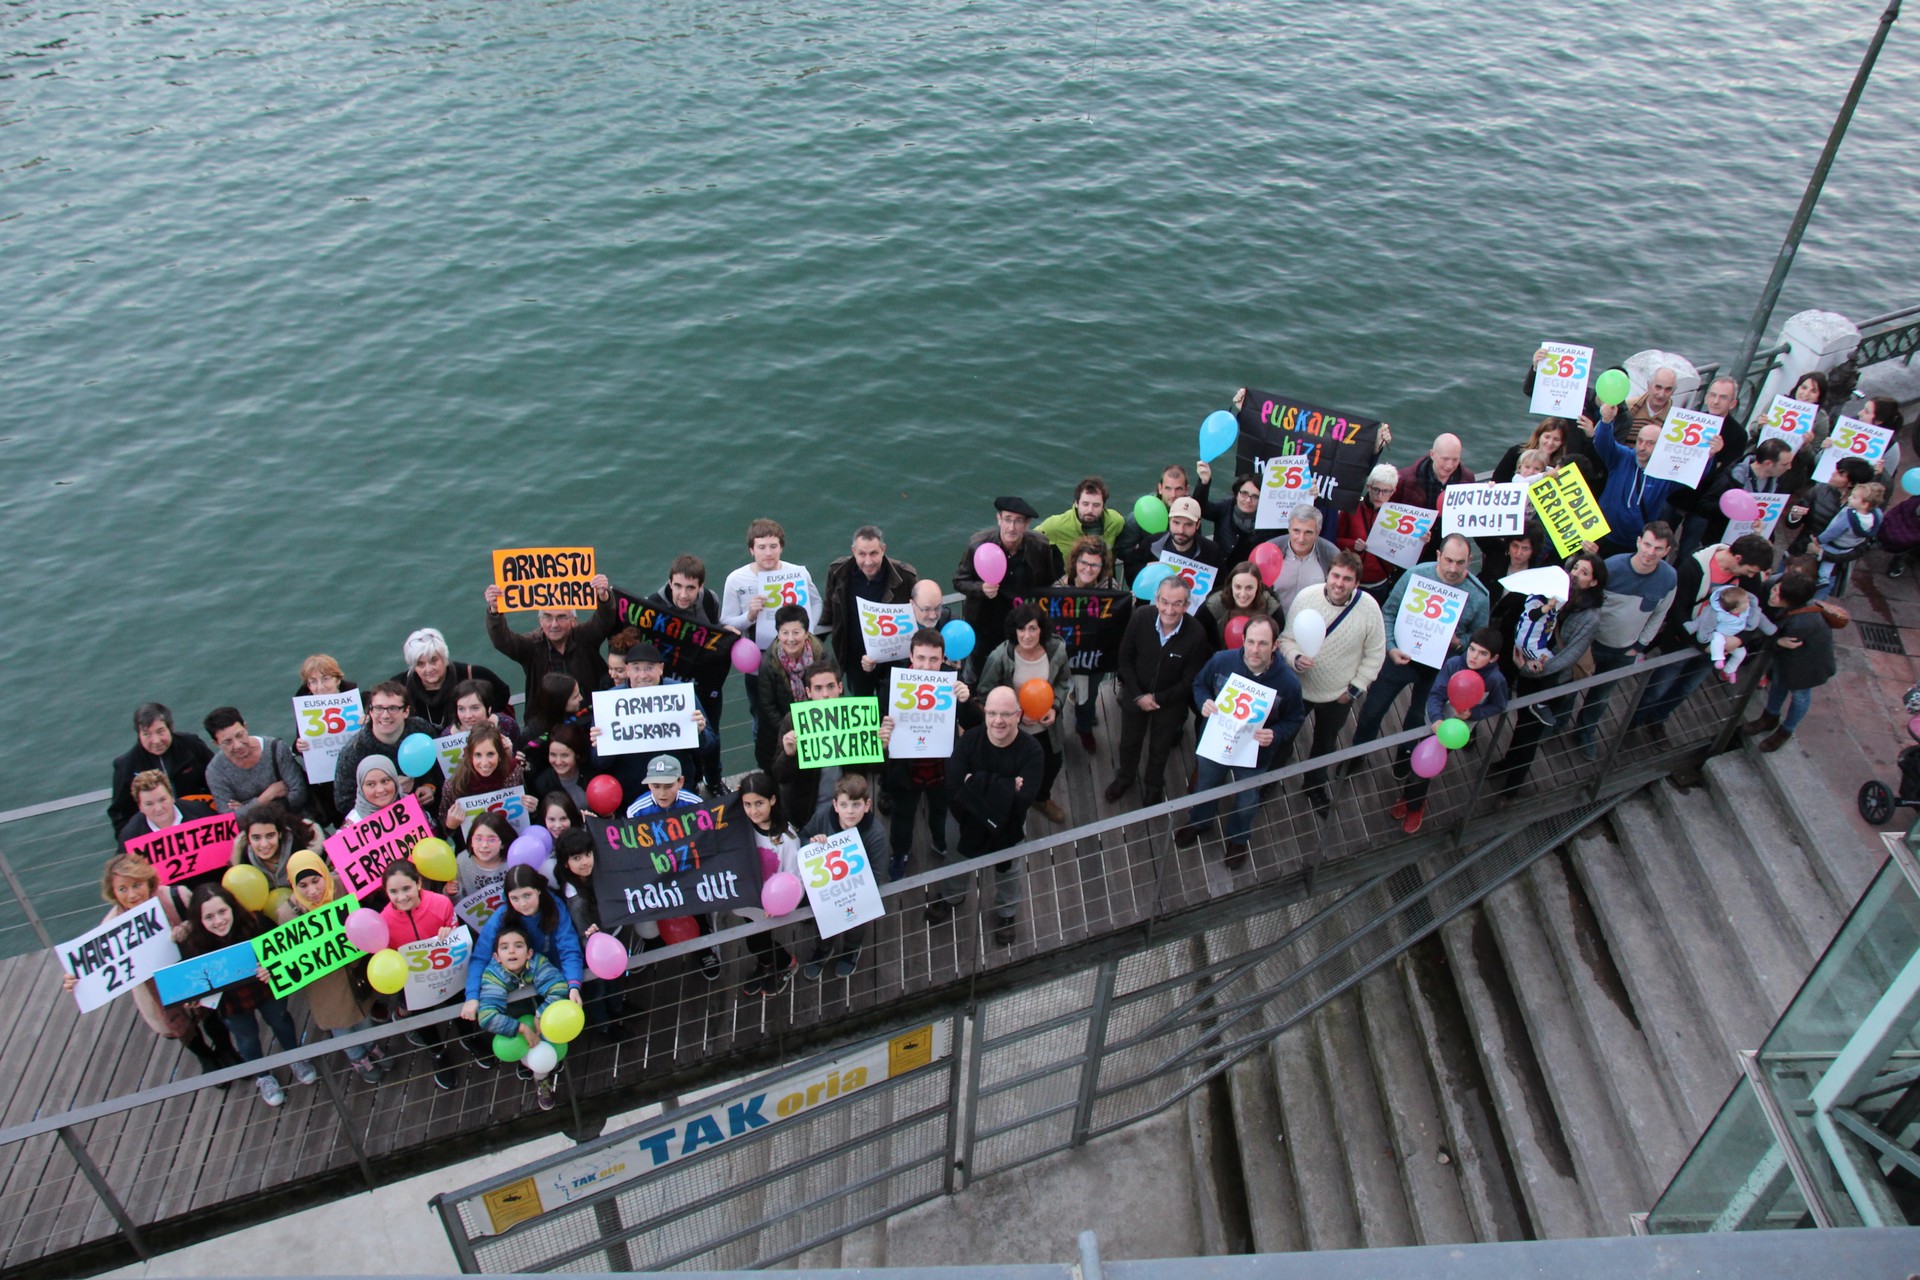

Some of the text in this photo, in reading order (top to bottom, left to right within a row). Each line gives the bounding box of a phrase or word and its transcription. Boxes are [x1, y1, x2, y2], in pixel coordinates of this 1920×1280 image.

[1548, 346, 1586, 356] EUSKARAK
[1540, 353, 1588, 380] 365
[1542, 377, 1580, 390] EGUN
[1676, 412, 1717, 426] EUSKARAK
[1777, 399, 1812, 412] EUSKARAK
[1261, 400, 1361, 445] euskaraz
[1664, 418, 1717, 448] 365
[1767, 406, 1812, 435] 365
[1844, 420, 1884, 437] EUSKARAK
[1663, 443, 1704, 458] EGUN
[1833, 427, 1884, 458] 365
[1266, 465, 1313, 490] 365
[1389, 504, 1430, 519] EUSKARAK
[1557, 469, 1600, 531] LIPDUB
[1379, 509, 1431, 539] 365
[1379, 528, 1418, 548] EGUN
[502, 552, 591, 582] ARNASTU
[1168, 555, 1210, 572] EUSKARAK
[766, 572, 802, 583] EUSKARAK
[1417, 580, 1460, 600] EUSKARAK
[504, 581, 596, 608] EUSKARA
[763, 580, 807, 609] 365
[1405, 587, 1460, 624] 365
[862, 603, 905, 614] EUSKARAK
[618, 597, 723, 652] euskaraz
[862, 611, 914, 637] 365
[1405, 614, 1446, 636] EGUN
[900, 673, 949, 684] EUSKARAK
[1231, 679, 1267, 699] EUSKARAK
[304, 696, 353, 708] EUSKARAK
[615, 694, 686, 717] ARNASTU
[894, 682, 953, 711] 365
[1218, 687, 1268, 724] 365
[302, 704, 362, 737] 365
[797, 705, 878, 735] ARNASTU
[899, 712, 945, 724] EGUN
[800, 730, 879, 762] EUSKARA
[465, 790, 516, 809] EUSKARAK
[605, 804, 729, 850] euskaraz
[133, 820, 237, 865] MAIATZAK
[804, 835, 852, 859] EUSKARAK
[165, 853, 199, 880] 27
[650, 841, 701, 875] bizi
[804, 843, 865, 888] 365
[624, 870, 740, 914] nahi dut
[818, 874, 866, 902] EGUN
[67, 907, 164, 980] MAIATZAK
[262, 902, 350, 961] ARNASTU
[408, 934, 461, 951] EUSKARAK
[266, 932, 360, 992] EUSKAR
[405, 942, 468, 972] 365
[102, 956, 136, 993] 27
